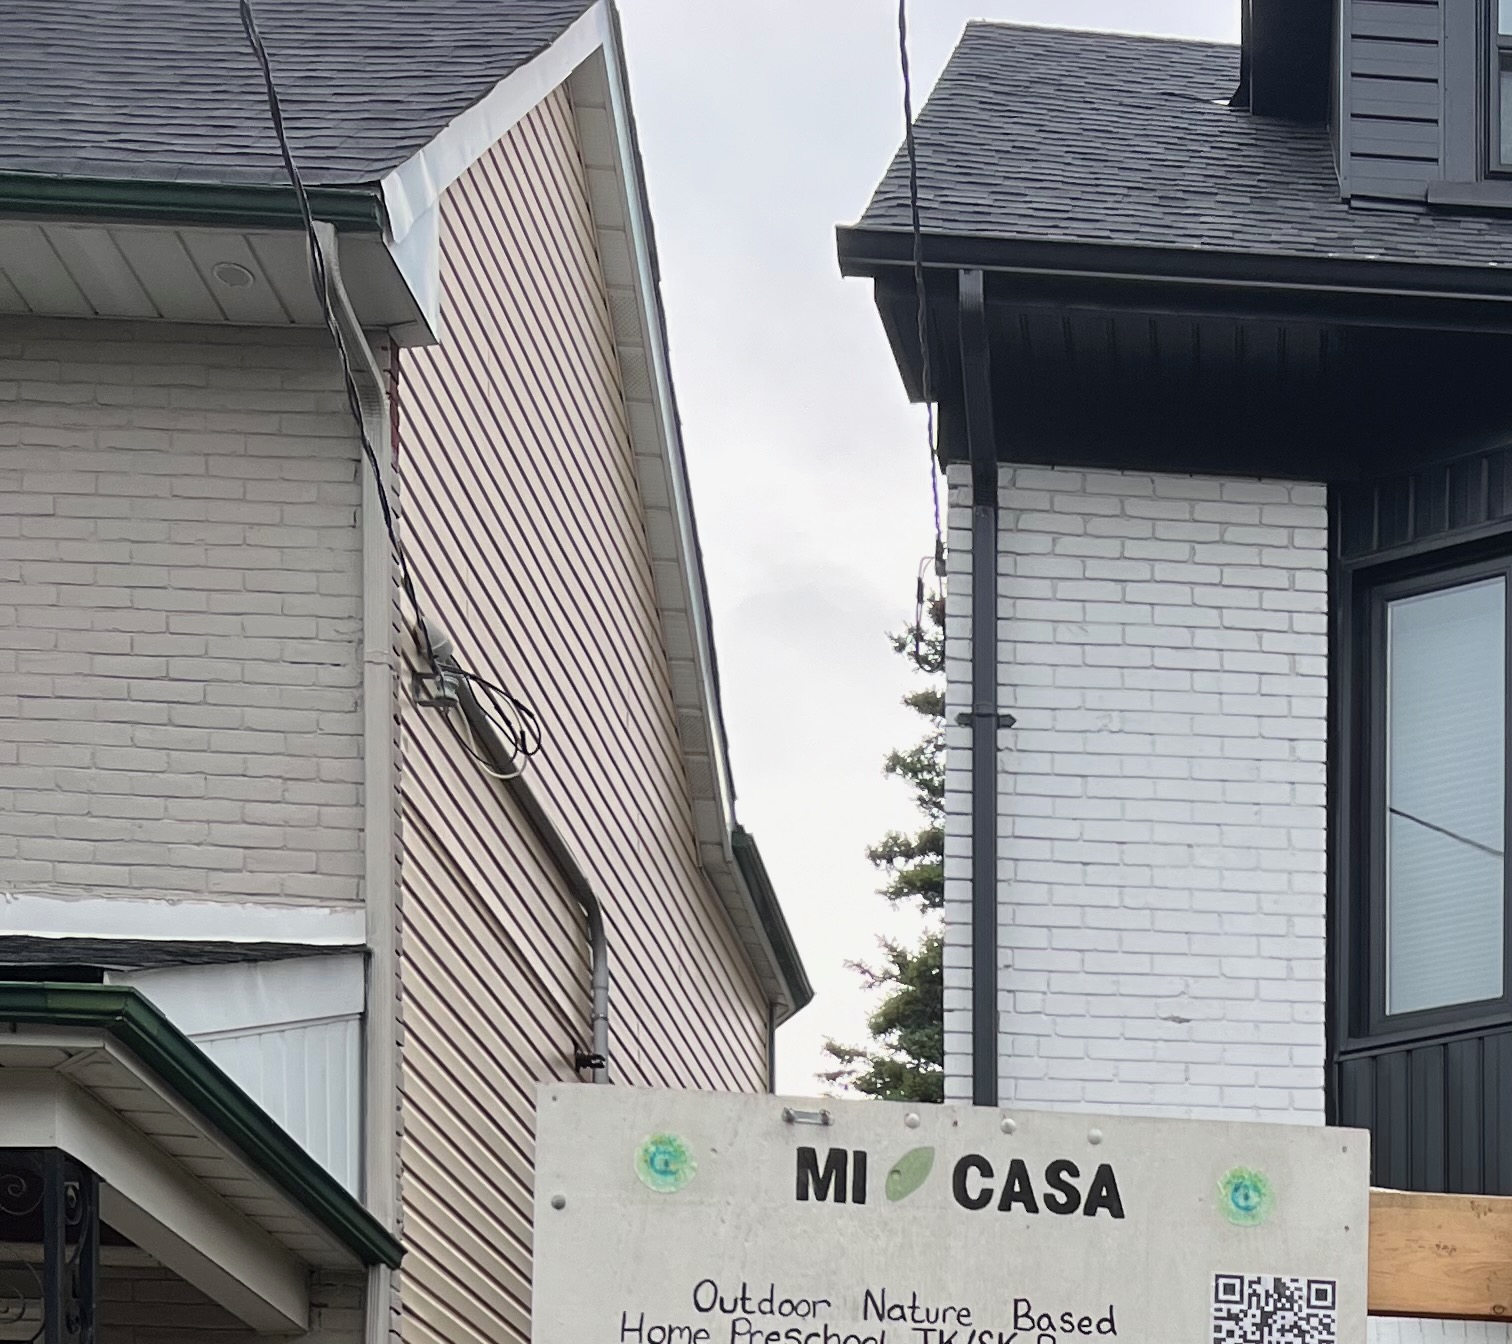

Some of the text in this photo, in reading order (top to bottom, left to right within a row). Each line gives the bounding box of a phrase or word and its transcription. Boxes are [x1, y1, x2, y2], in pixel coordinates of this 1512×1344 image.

[796, 1146, 1126, 1220] MI CASA
[693, 1278, 1118, 1336] Outdoor Nature Based
